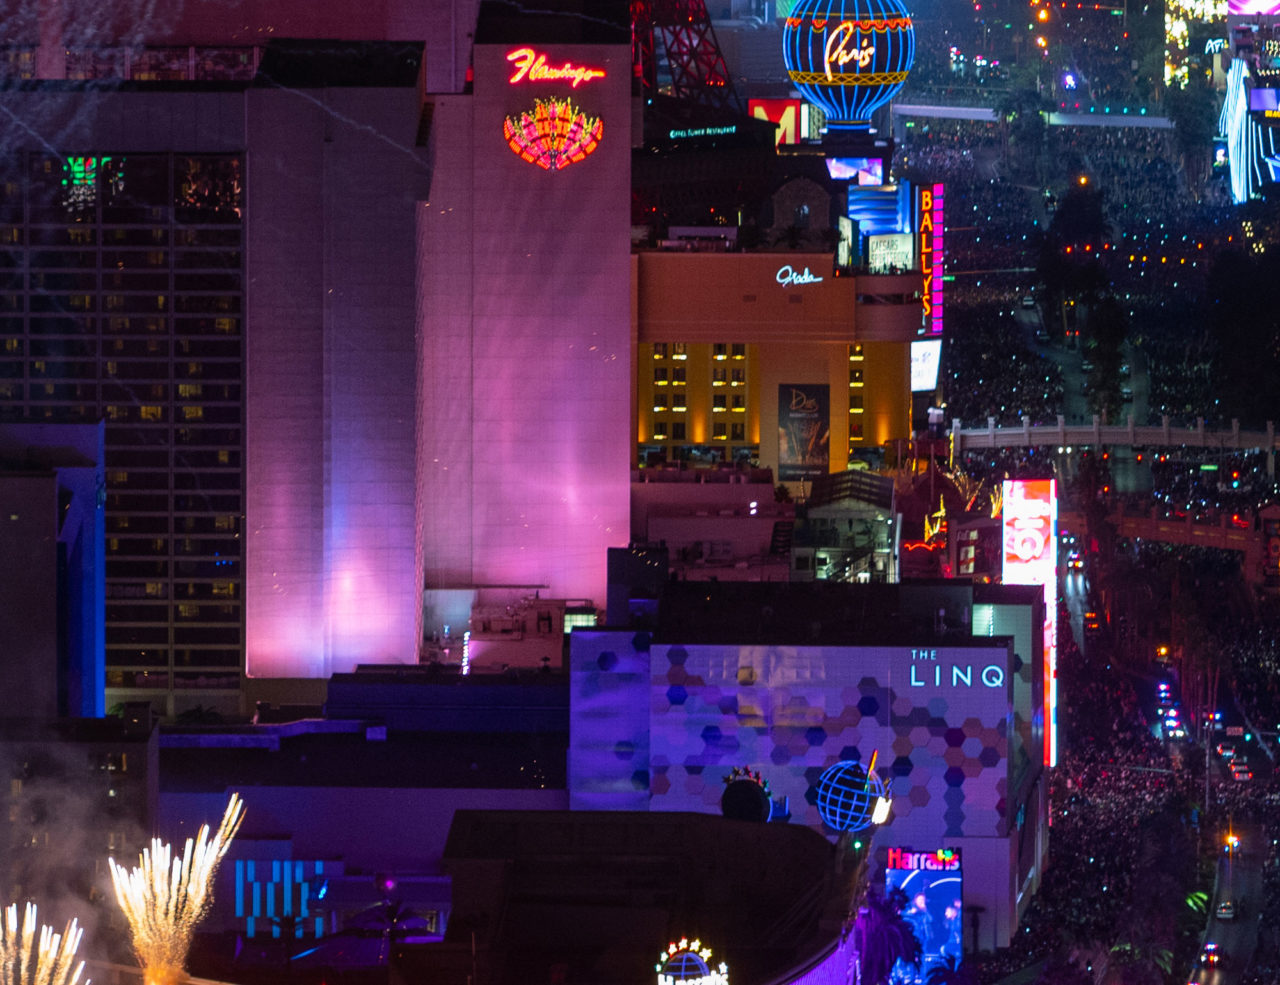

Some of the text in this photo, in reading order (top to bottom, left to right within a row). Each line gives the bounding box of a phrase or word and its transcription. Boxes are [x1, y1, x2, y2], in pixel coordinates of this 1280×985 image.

[506, 47, 606, 88] Flamingo
[824, 21, 876, 82] Paris
[911, 649, 937, 660] THE
[910, 664, 1004, 687] LINQ
